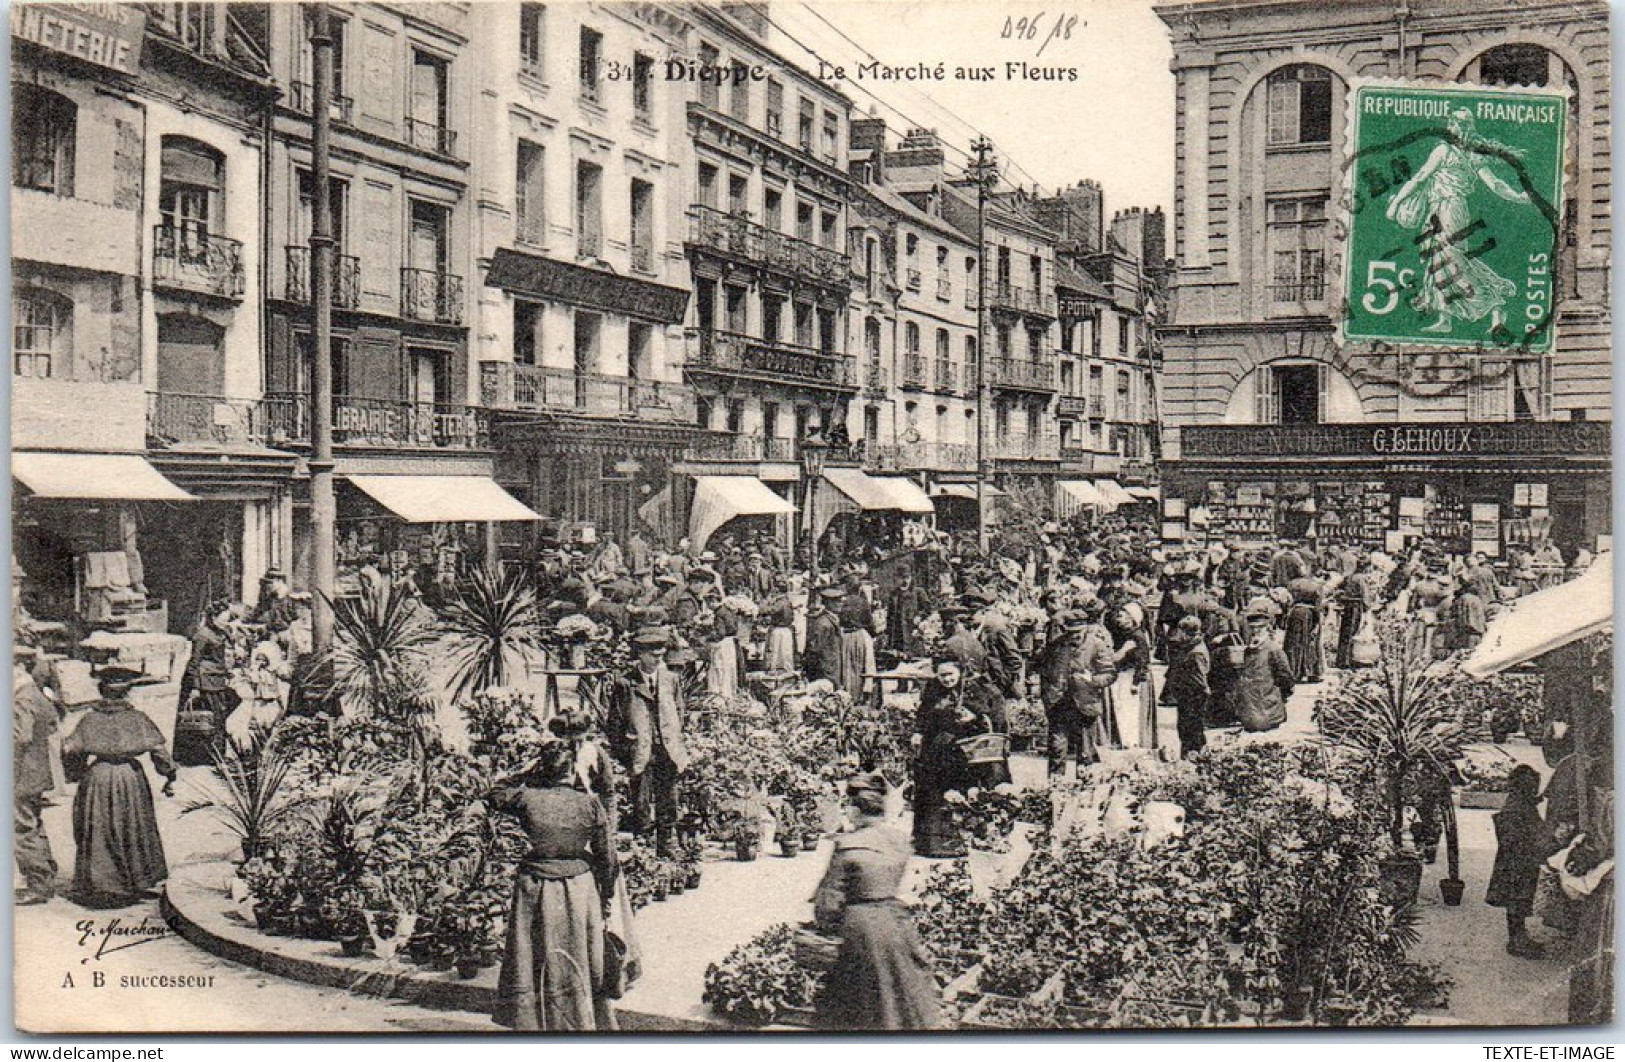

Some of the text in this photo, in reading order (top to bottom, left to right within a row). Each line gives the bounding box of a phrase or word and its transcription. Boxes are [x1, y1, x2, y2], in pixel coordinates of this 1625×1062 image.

[1364, 96, 1556, 124] REPUBLIQUE FRANÇAISE
[1523, 252, 1548, 334] POSTES
